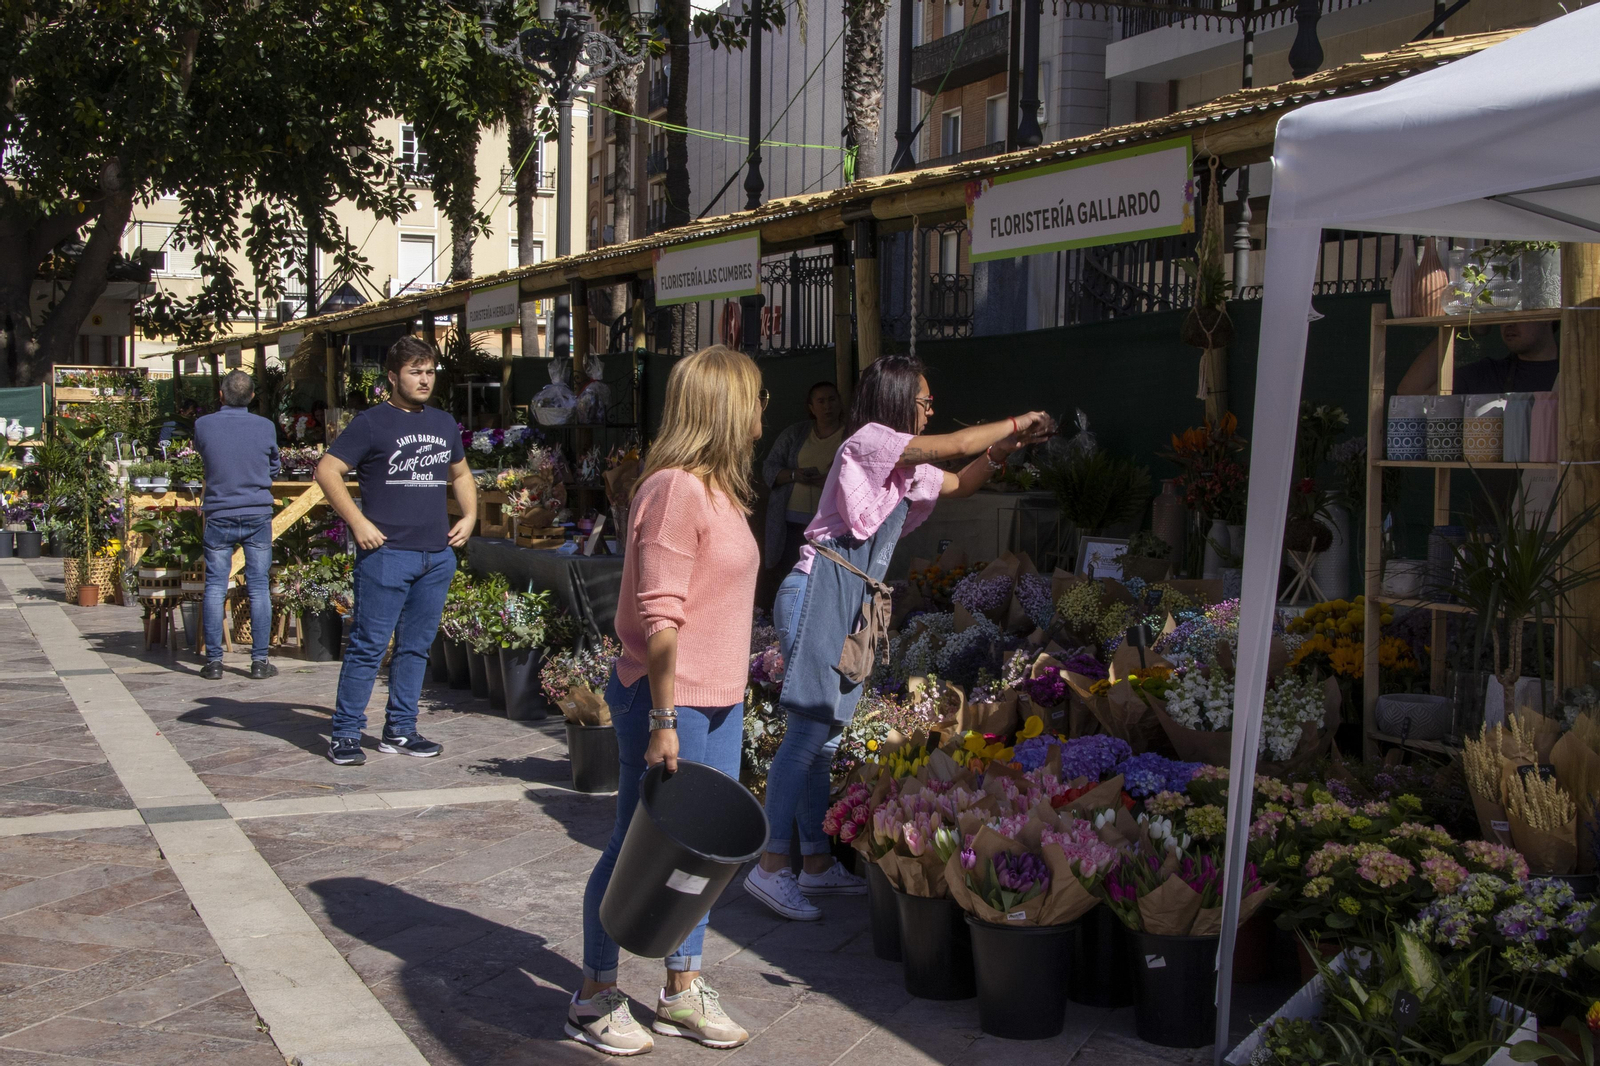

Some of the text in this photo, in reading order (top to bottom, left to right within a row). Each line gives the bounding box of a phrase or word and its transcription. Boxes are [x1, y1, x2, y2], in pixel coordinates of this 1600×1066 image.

[990, 189, 1160, 239] FLORISTERÍA GALLARDO
[661, 263, 753, 291] FLORISTERÍA LAS CUMBRES
[396, 434, 447, 448] SANTA BARBARA
[411, 471, 434, 481] Beach
